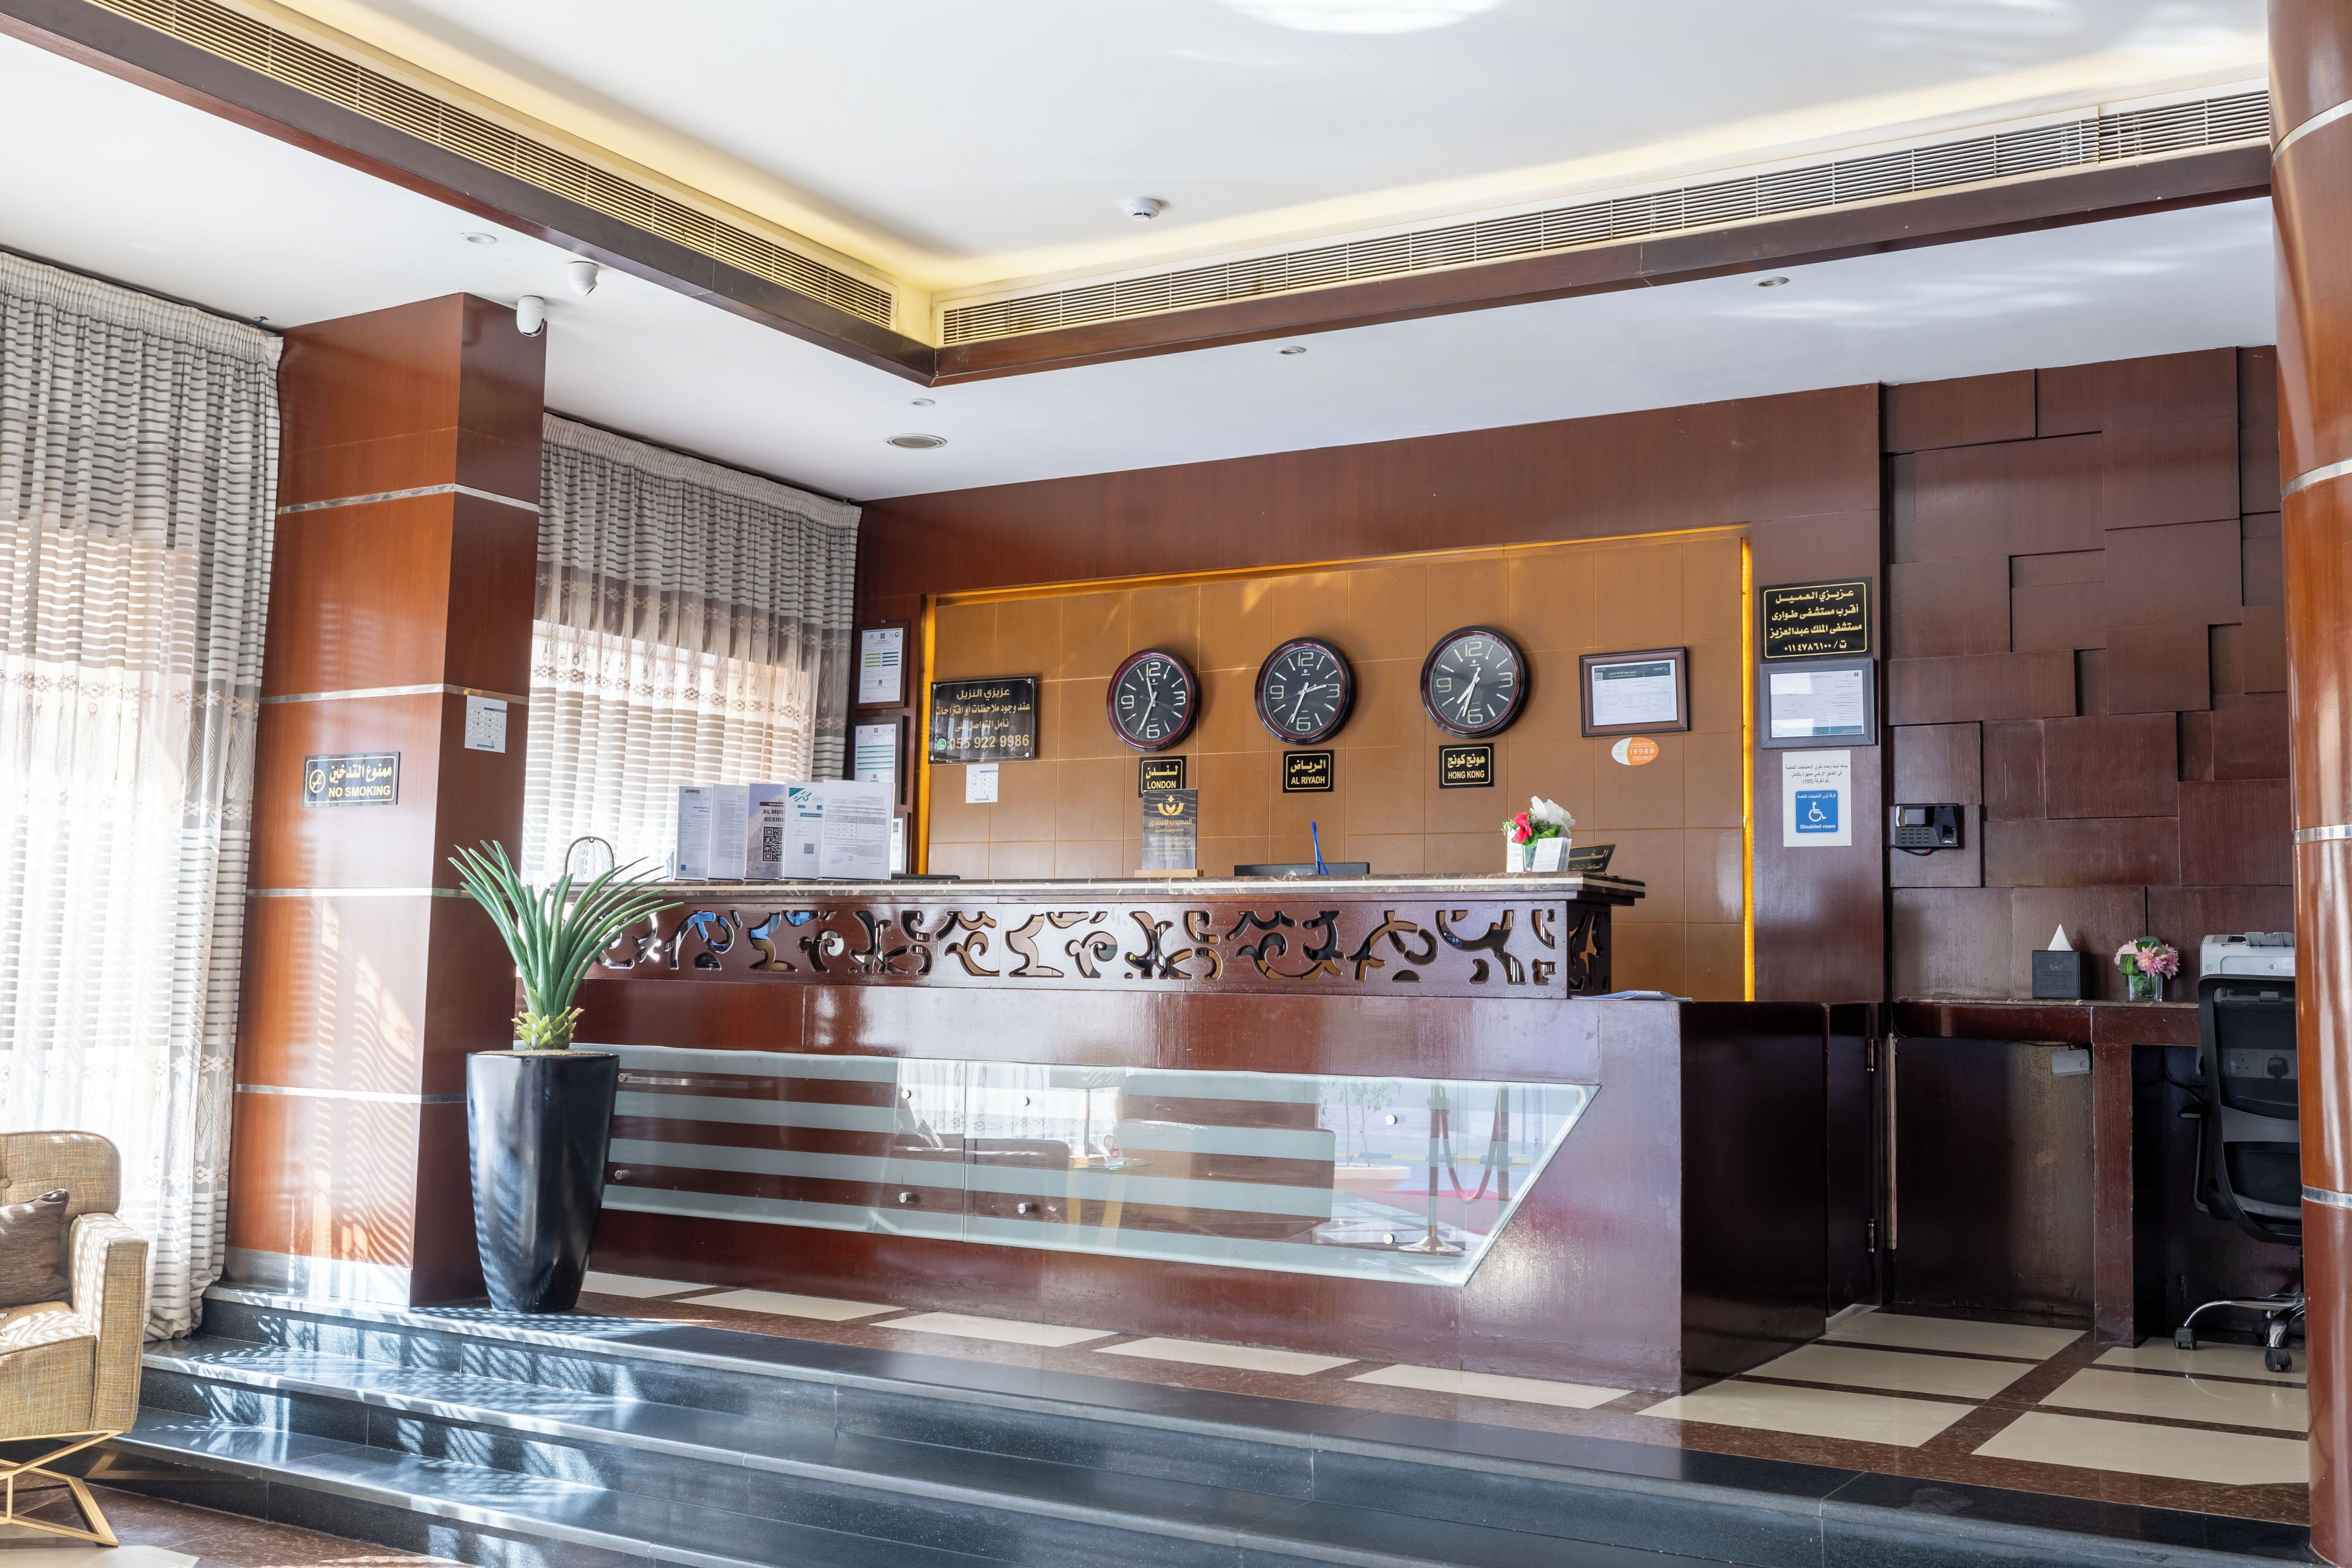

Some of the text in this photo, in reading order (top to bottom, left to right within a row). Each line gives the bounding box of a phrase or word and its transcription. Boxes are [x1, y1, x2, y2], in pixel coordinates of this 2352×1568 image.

[1776, 589, 1854, 604] عزيزي العميل
[1800, 606, 1834, 619] مستشفى
[1836, 604, 1858, 616] أقرب
[1770, 622, 1862, 639] مستشفى الملك عبدالعزيز
[1465, 641, 1482, 657] 12
[1297, 652, 1314, 666] 12
[1146, 662, 1161, 676] 12
[1436, 677, 1452, 693] 9
[1498, 672, 1513, 688] 3
[957, 687, 1009, 701] عزيزي النزيل
[1270, 685, 1284, 699] 9
[1327, 684, 1340, 698] 3
[1121, 695, 1134, 709] 9
[1174, 691, 1186, 706] 3
[935, 705, 963, 716] اقتراحات
[972, 704, 1000, 713] ملاحظات
[1001, 704, 1017, 714] وجود
[1017, 702, 1030, 710] عند
[1468, 708, 1483, 724] 6
[1296, 717, 1311, 731] 6
[1147, 724, 1160, 739] 6
[949, 734, 1029, 750] 055 922 9986
[1291, 760, 1325, 773] الرياض
[1447, 753, 1485, 768] هونج كونج
[330, 763, 392, 784] ممنوع التدخين
[1145, 765, 1178, 779] لندن
[328, 785, 391, 797] NO SMOKING
[1147, 780, 1176, 789] LONDON
